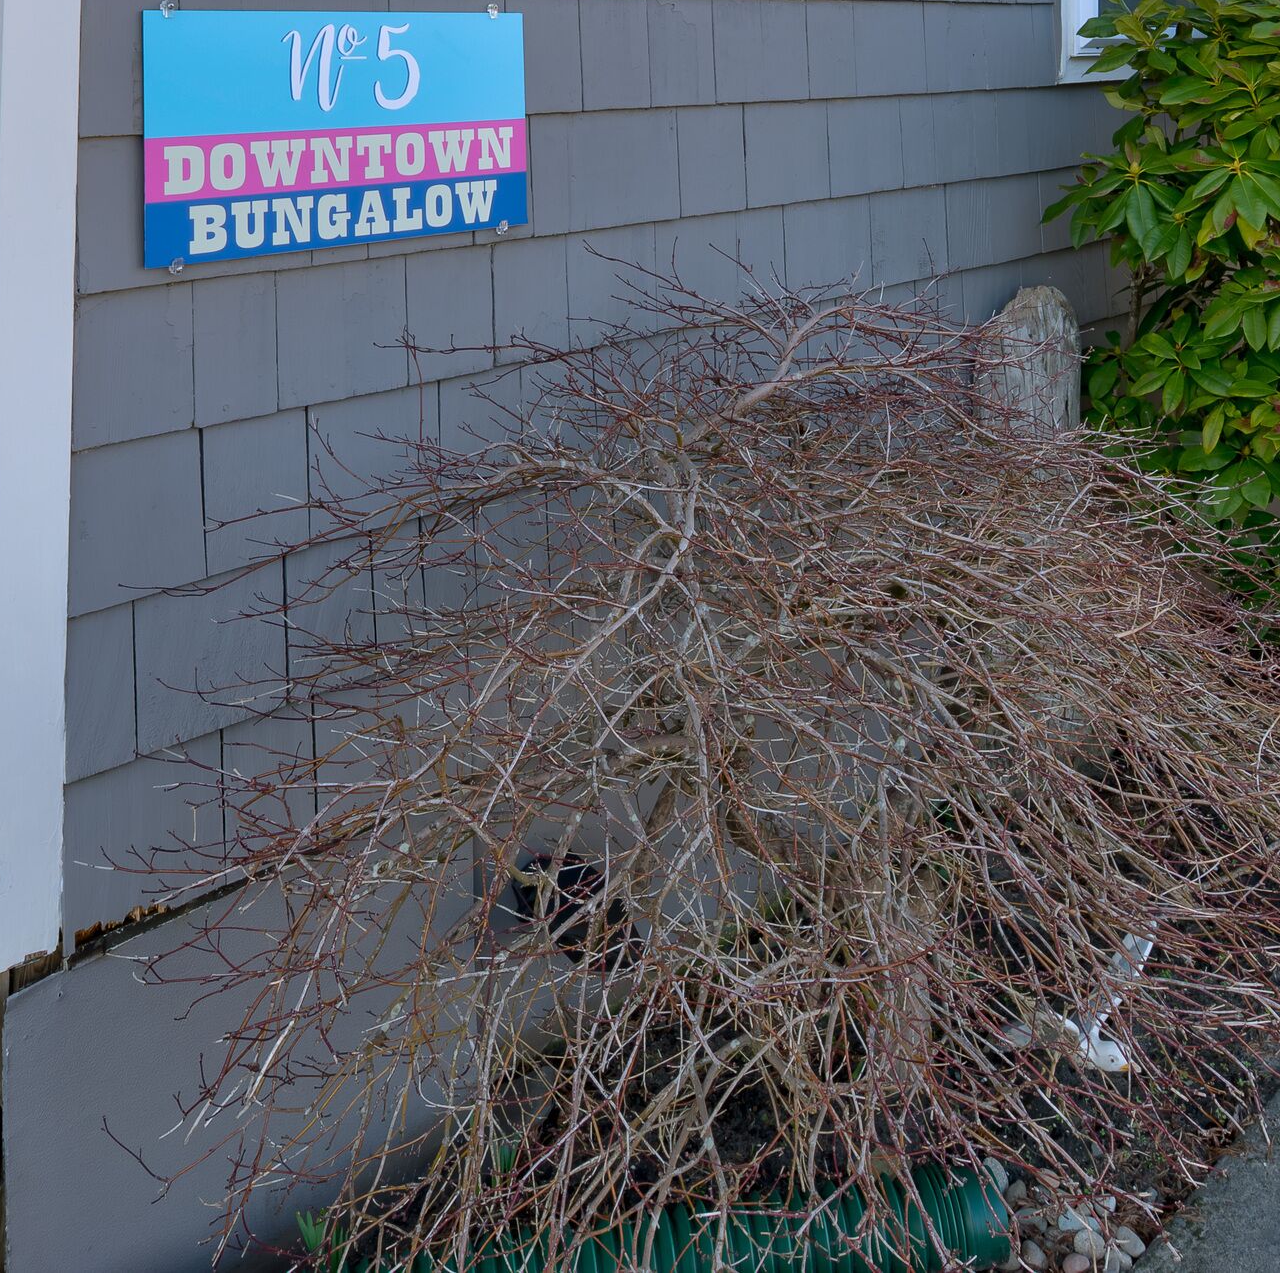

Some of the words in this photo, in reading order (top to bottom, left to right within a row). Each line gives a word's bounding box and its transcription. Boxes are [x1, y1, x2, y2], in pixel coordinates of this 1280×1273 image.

[374, 22, 421, 110] 5
[162, 126, 514, 196] DOWNTOWN
[188, 179, 498, 255] BUNGALOW
